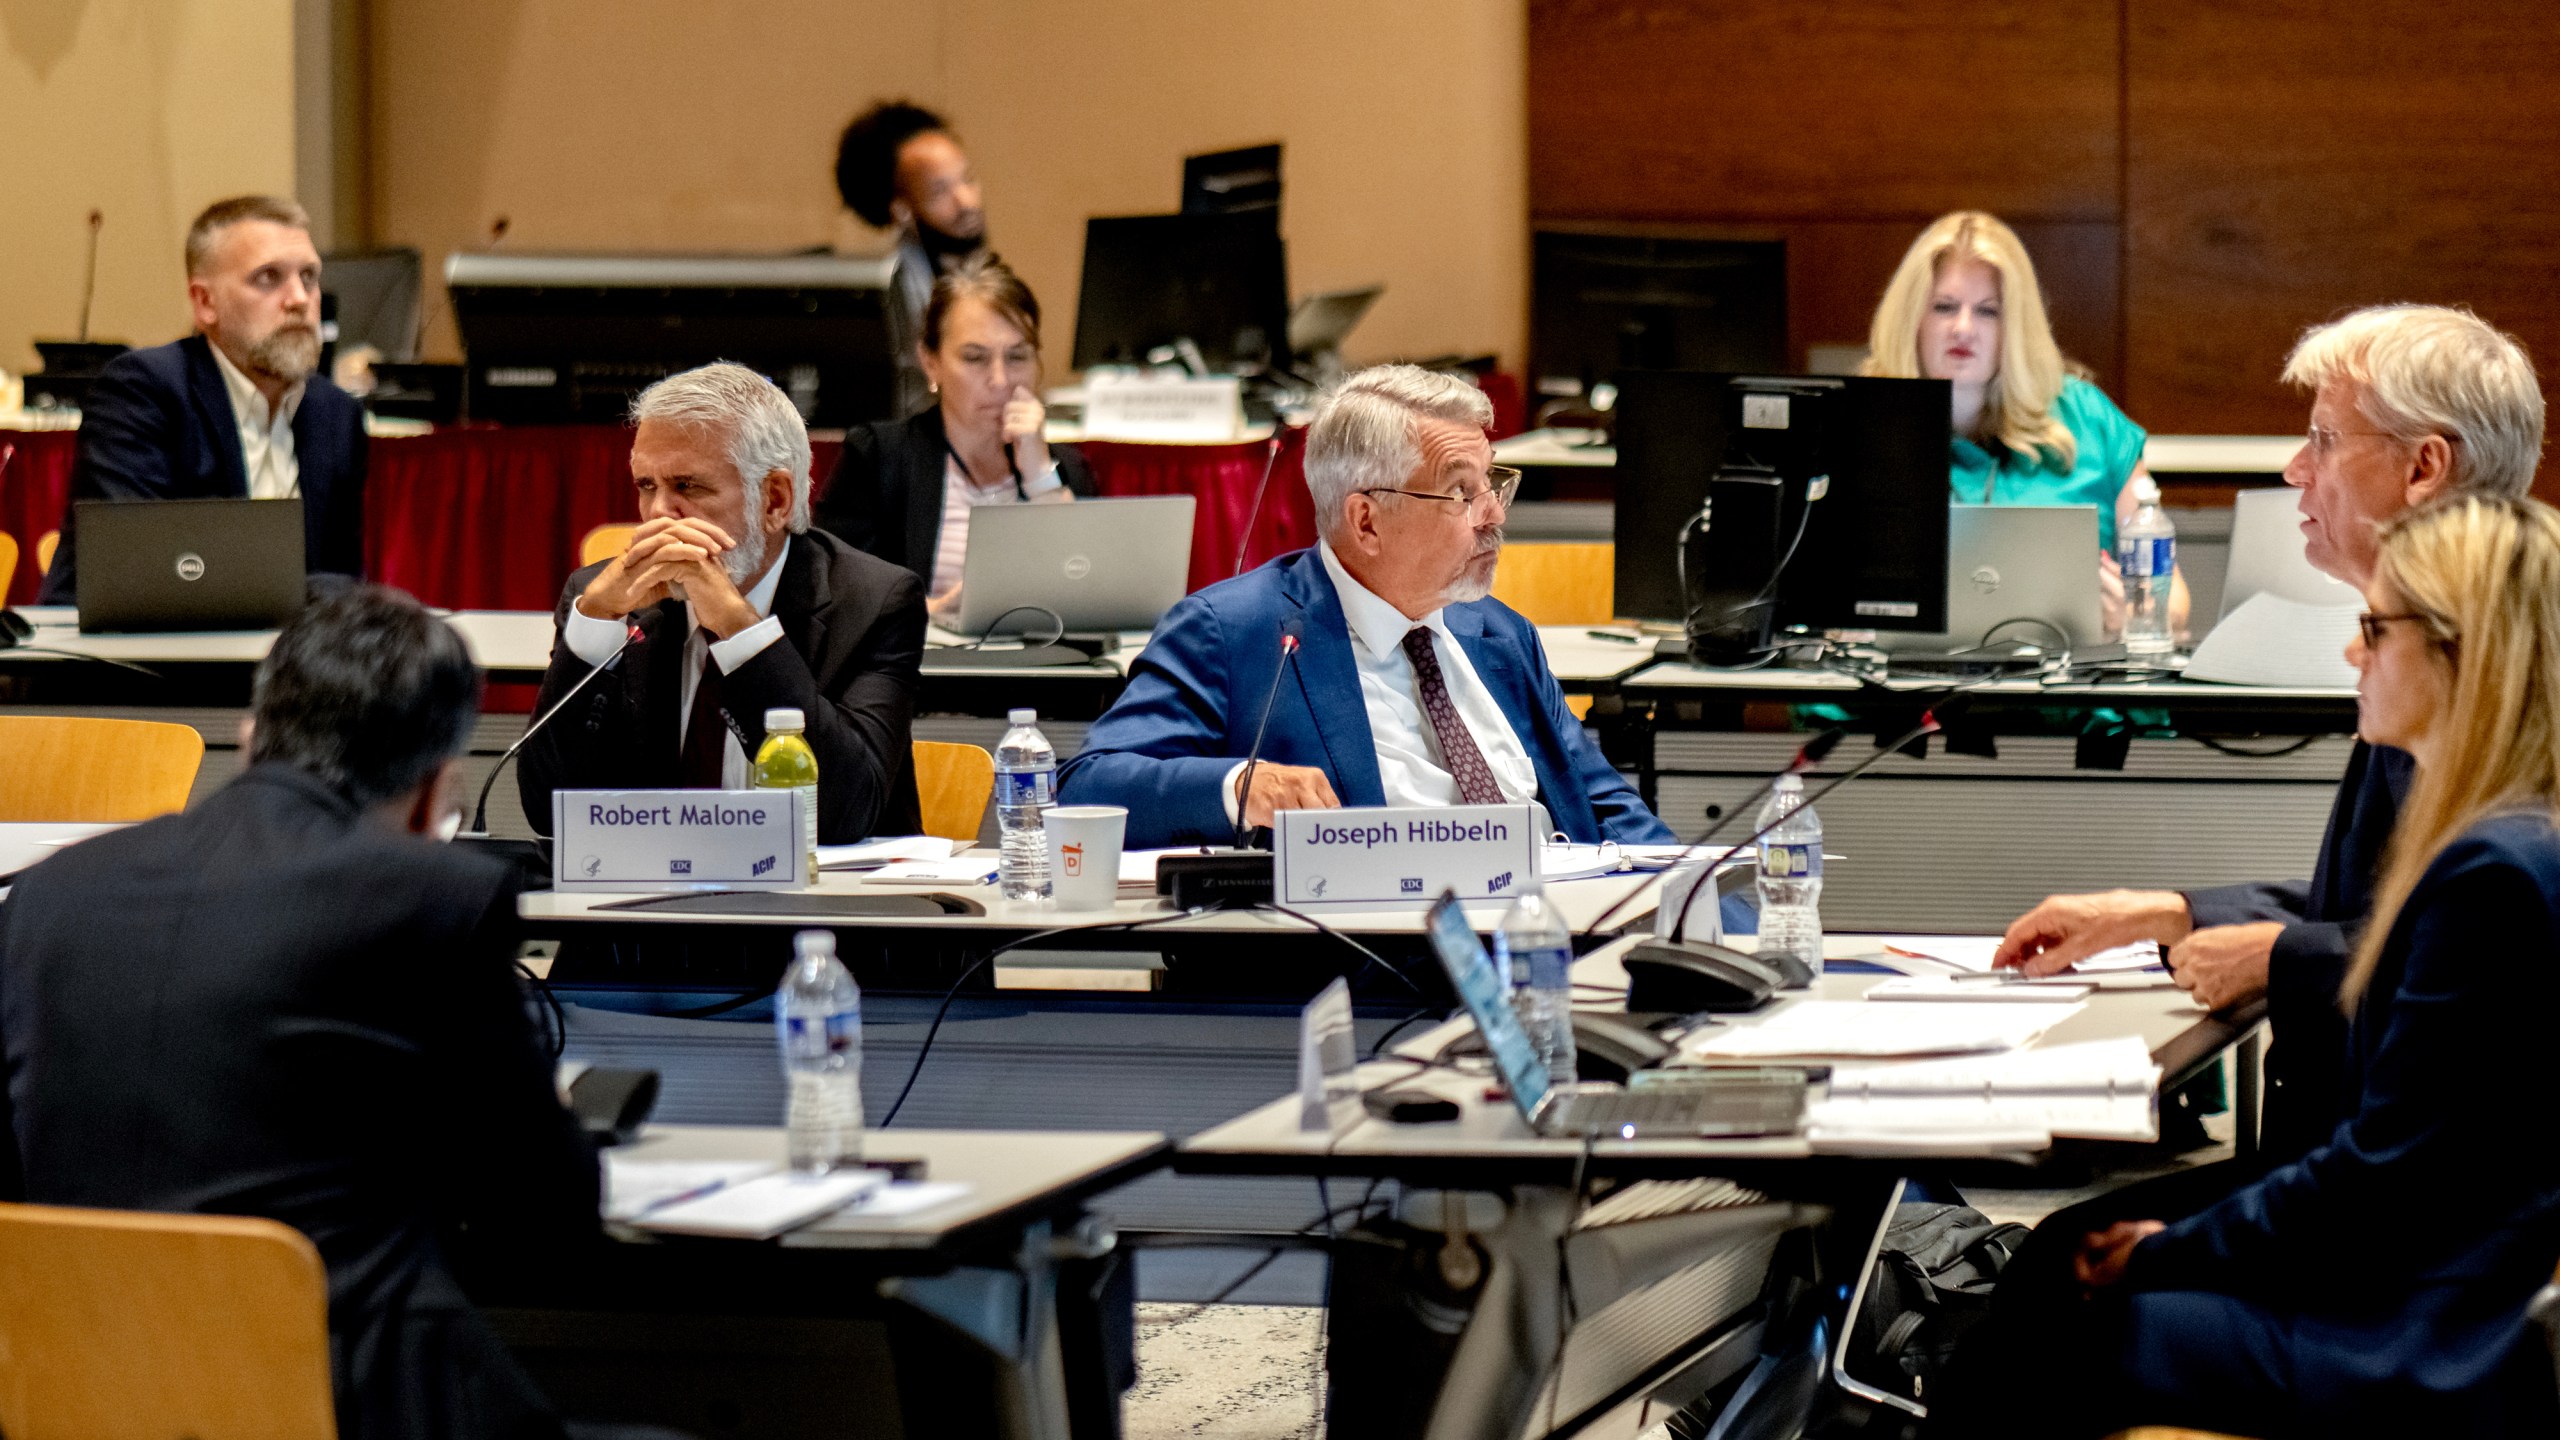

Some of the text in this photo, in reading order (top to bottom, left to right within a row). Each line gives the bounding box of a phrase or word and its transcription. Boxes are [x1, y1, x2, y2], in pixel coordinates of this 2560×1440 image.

[589, 803, 767, 826] Robert Malone
[1307, 819, 1508, 849] Joseph Hibbeln
[670, 861, 691, 871] CDC
[752, 855, 777, 877] ACIP
[1217, 878, 1273, 887] SENNHEISE
[1400, 879, 1423, 890] CDC
[1487, 871, 1513, 894] ACIP
